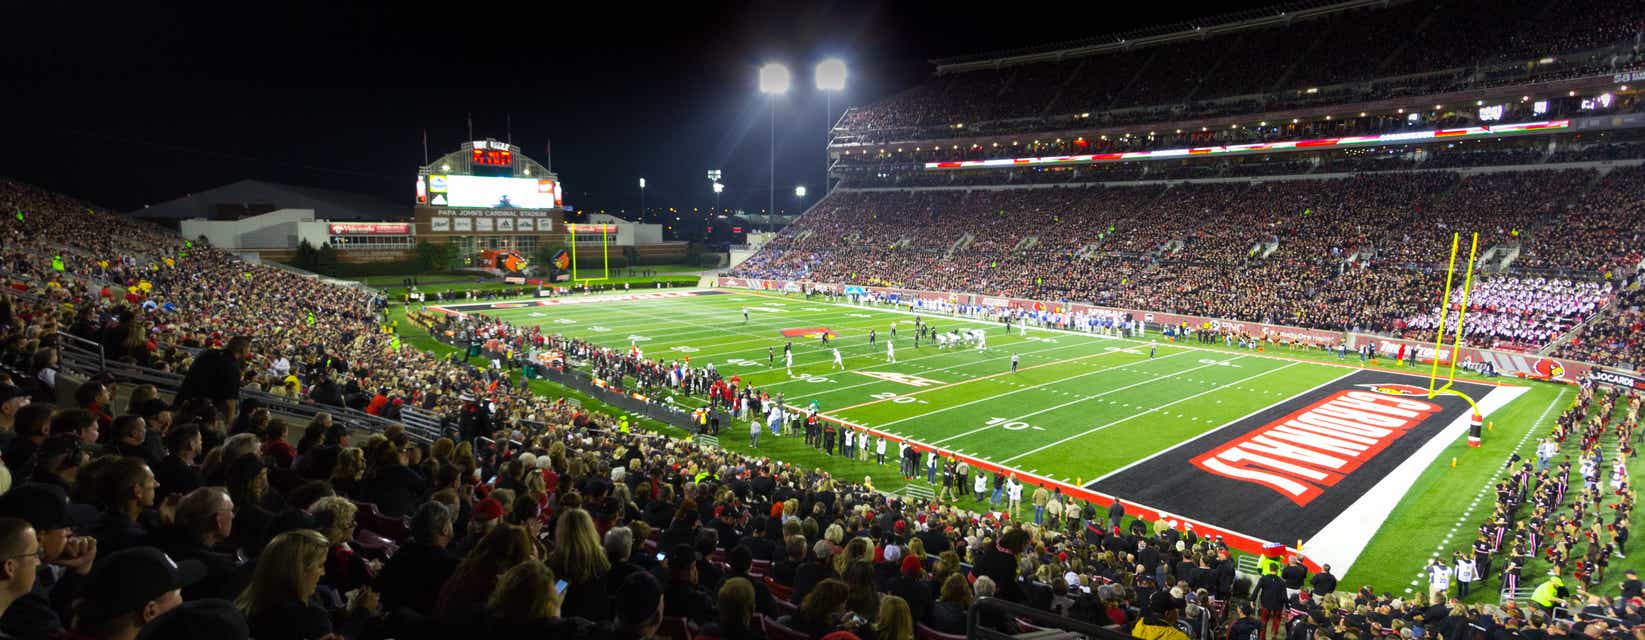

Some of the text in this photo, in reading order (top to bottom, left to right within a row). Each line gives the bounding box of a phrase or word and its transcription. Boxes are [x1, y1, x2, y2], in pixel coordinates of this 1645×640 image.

[870, 392, 917, 404] 20
[985, 416, 1030, 430] 10
[1202, 391, 1432, 497] CARDINALS
